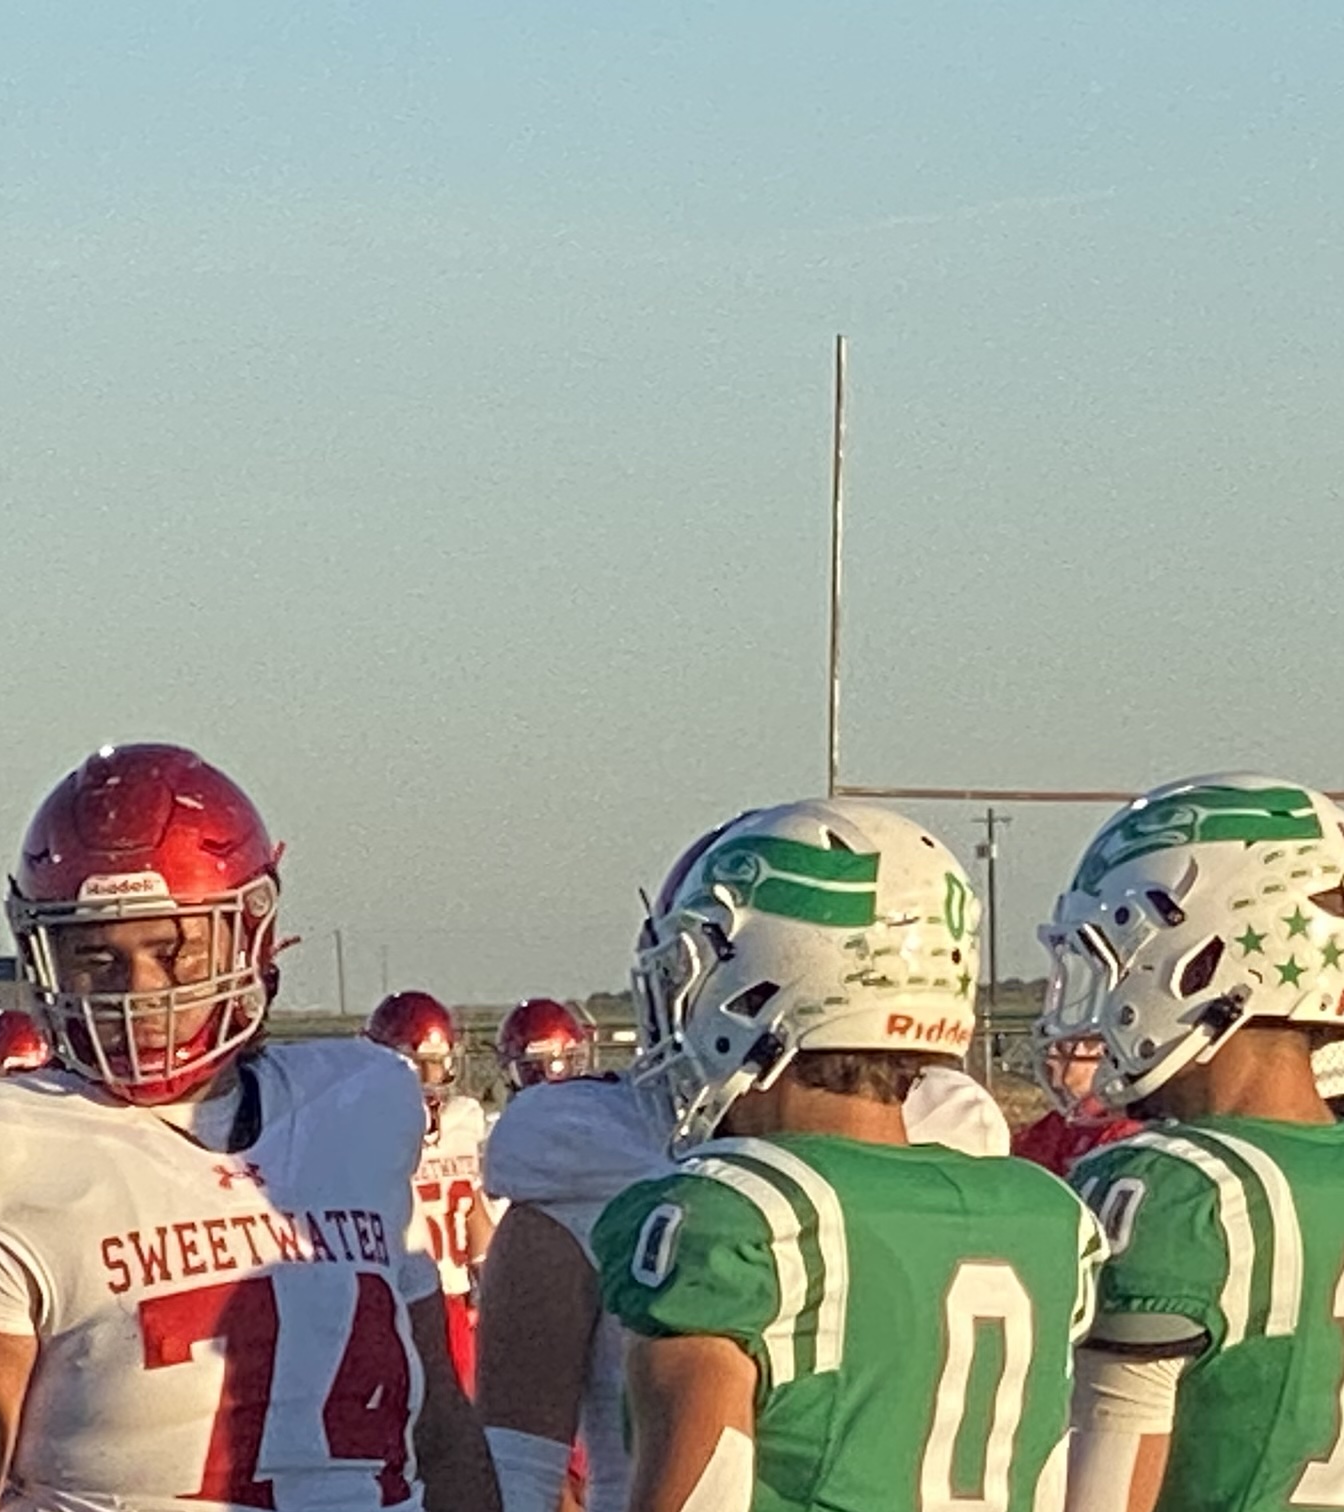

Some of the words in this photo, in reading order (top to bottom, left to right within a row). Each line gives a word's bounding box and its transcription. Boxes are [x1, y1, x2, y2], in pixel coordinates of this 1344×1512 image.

[101, 1210, 391, 1294] SWEETWATER
[631, 1202, 683, 1287] 0
[139, 1272, 412, 1510] 74
